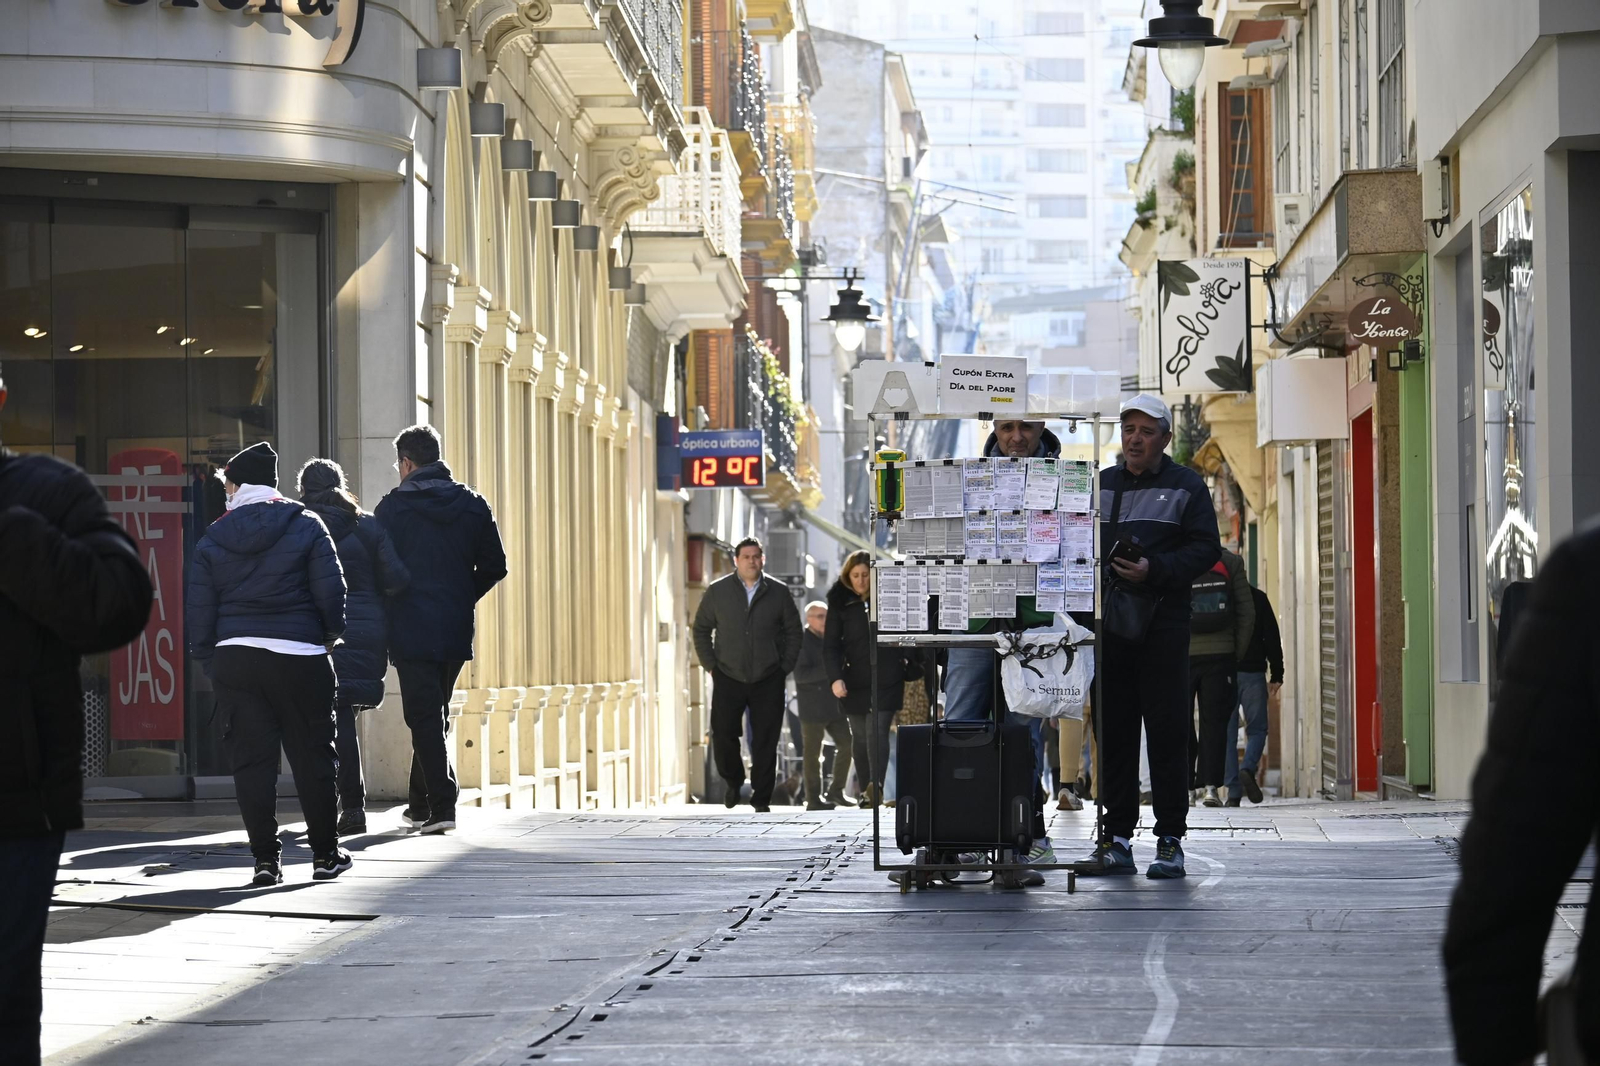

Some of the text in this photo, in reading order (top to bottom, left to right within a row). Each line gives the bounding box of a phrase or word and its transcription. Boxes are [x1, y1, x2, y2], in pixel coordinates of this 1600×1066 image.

[1203, 261, 1225, 269] Desde
[1367, 298, 1391, 315] La
[952, 368, 1014, 378] CUPÓN EXTRA
[950, 382, 965, 391] DÍA
[987, 384, 1016, 393] PADRE
[682, 437, 760, 451] óptica urbano
[693, 457, 718, 486] 12
[121, 464, 164, 541] RE
[118, 627, 176, 706] JAS
